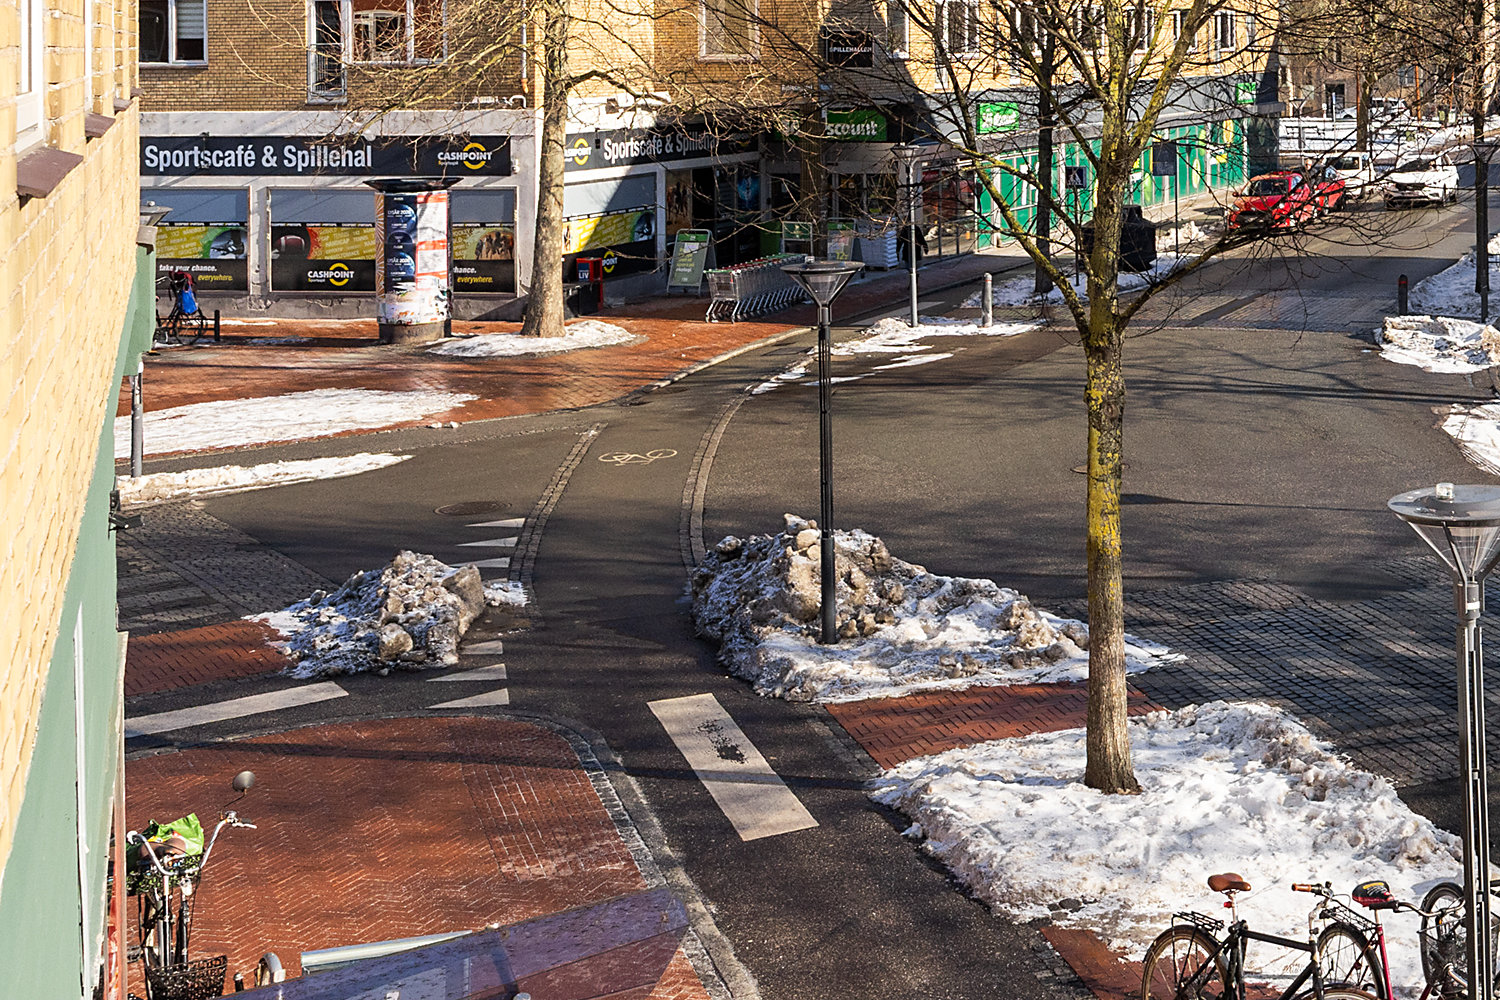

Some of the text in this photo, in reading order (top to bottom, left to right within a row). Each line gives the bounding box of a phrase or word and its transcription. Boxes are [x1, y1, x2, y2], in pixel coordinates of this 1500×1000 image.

[826, 121, 878, 136] scount
[664, 135, 673, 154] &
[145, 144, 372, 172] Sportscafé & Spillehal
[437, 151, 493, 160] CASHPOINT
[602, 257, 617, 266] POINT
[175, 264, 190, 272] your
[191, 264, 218, 272] chance.
[307, 270, 355, 278] CASHPOINT
